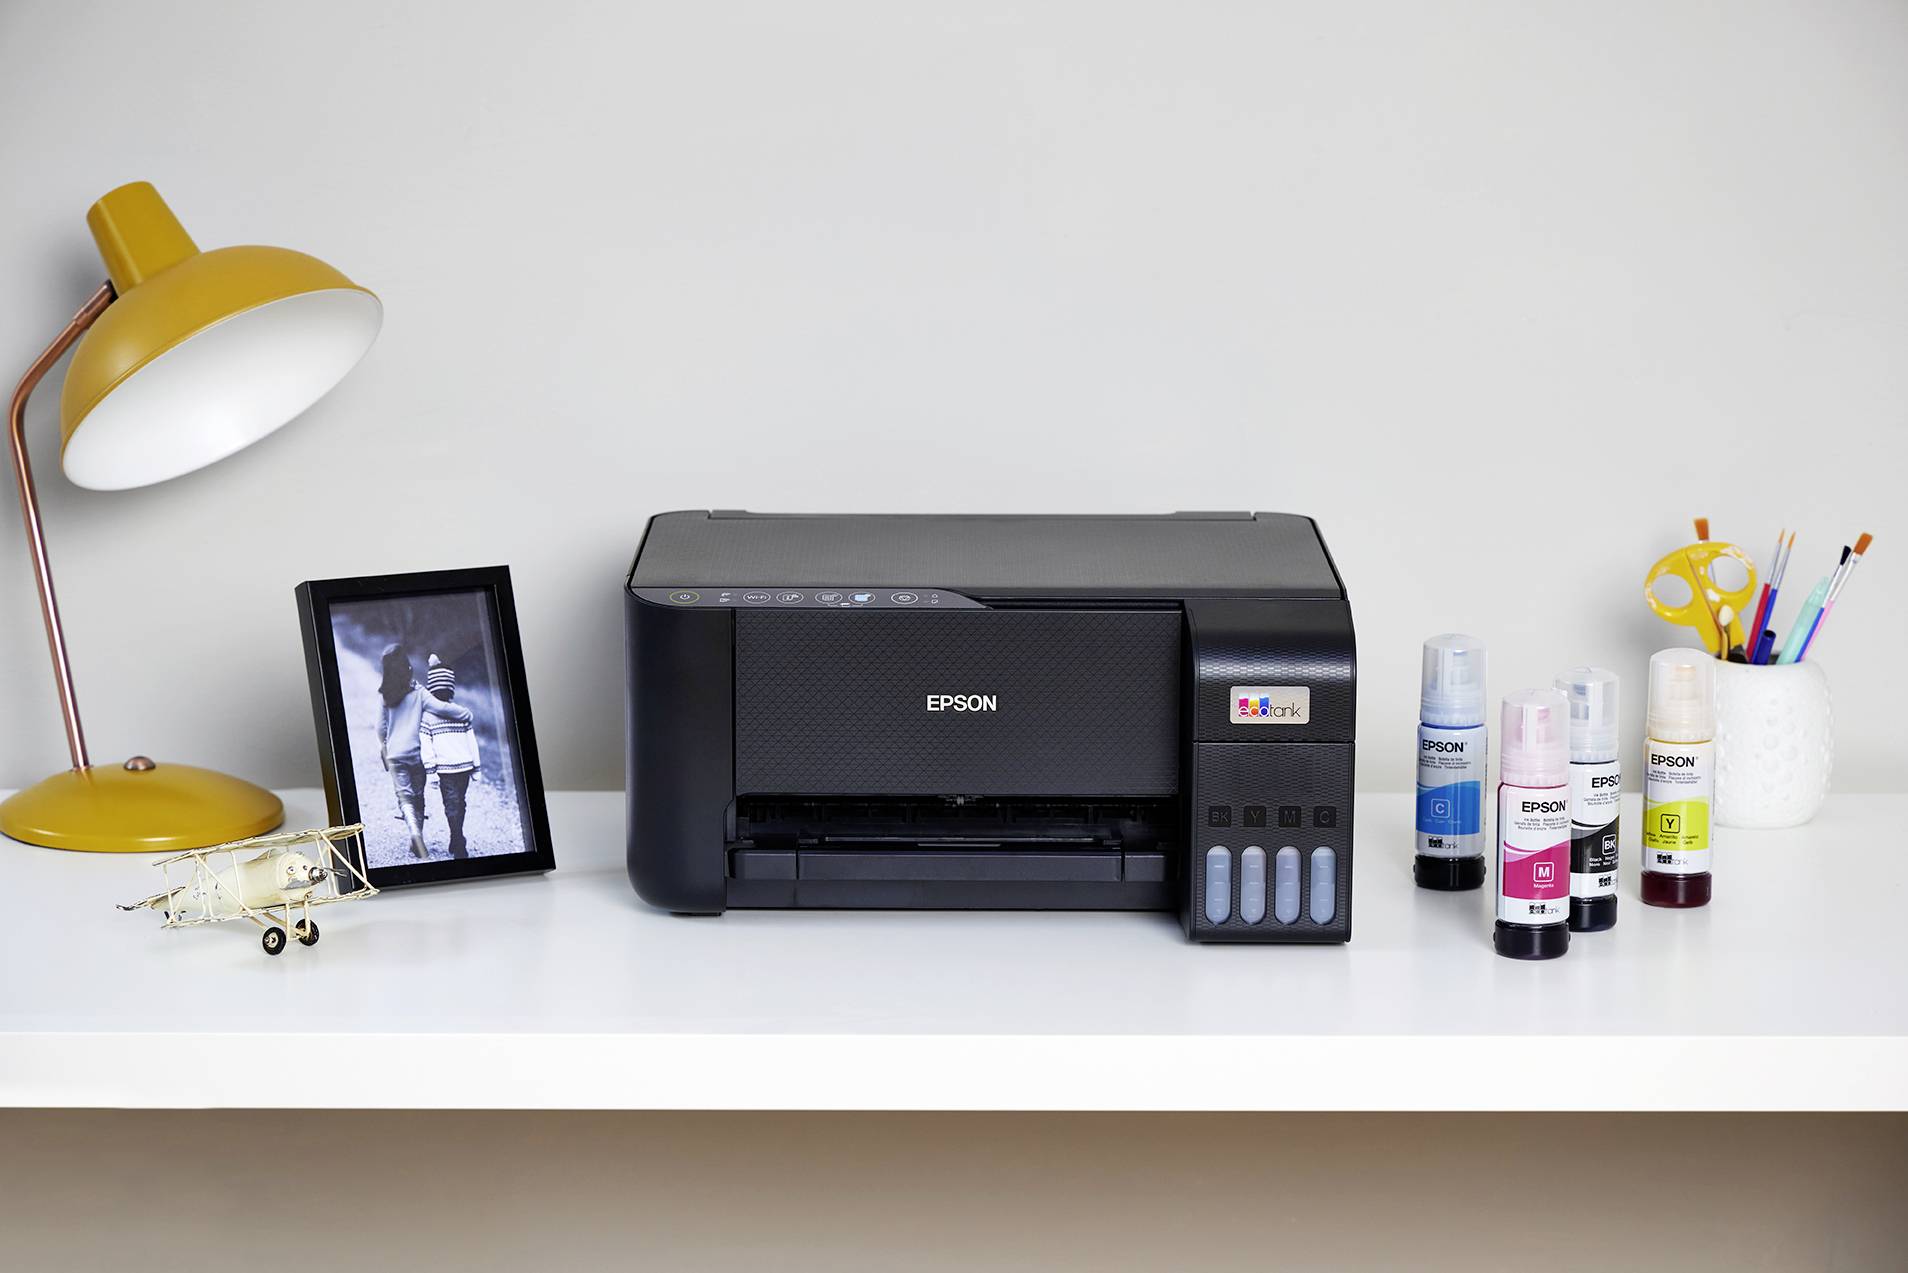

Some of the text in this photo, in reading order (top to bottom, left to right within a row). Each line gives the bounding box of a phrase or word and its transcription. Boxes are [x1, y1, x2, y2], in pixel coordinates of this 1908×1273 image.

[926, 694, 997, 712] EPSON
[1238, 701, 1301, 717] ecotank
[1422, 739, 1464, 753] EPSON
[1651, 753, 1695, 768] EPSON
[1435, 803, 1445, 814] C
[1521, 800, 1566, 813] EPSON
[1212, 811, 1229, 823] BK
[1250, 811, 1260, 823] Y
[1284, 811, 1296, 823] M
[1319, 811, 1330, 823] C
[1666, 818, 1675, 829] Y
[1604, 840, 1616, 850] BK
[1538, 866, 1550, 878] M
